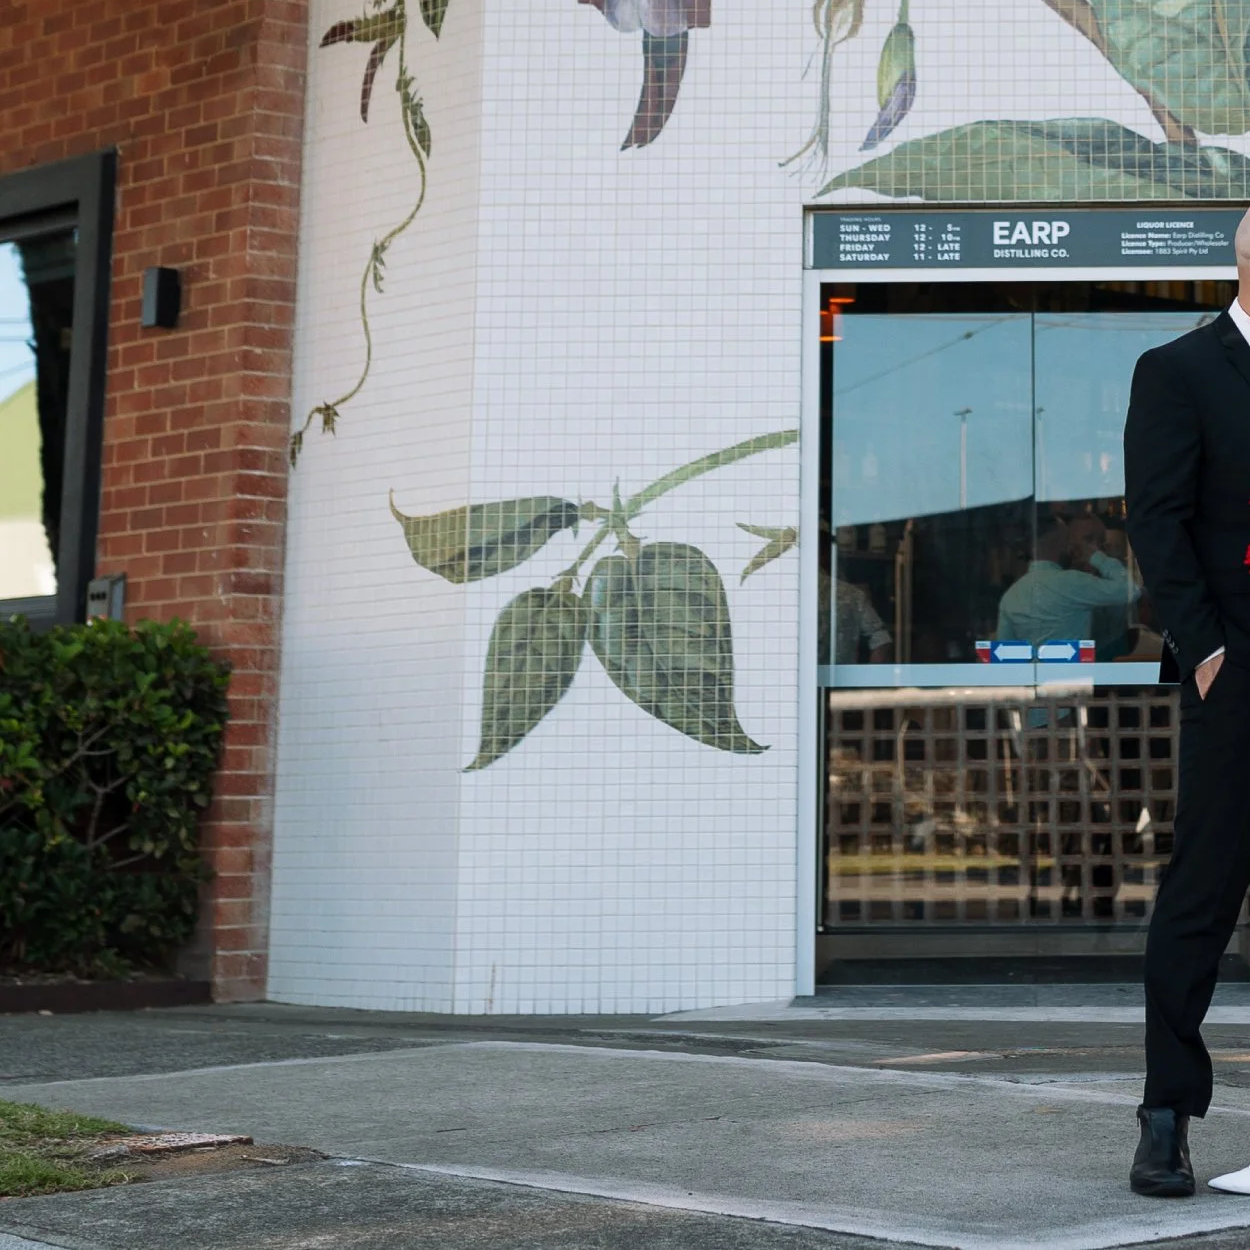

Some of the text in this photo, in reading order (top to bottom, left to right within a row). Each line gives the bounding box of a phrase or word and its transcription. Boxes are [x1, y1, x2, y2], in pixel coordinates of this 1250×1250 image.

[839, 224, 860, 232] SUN
[868, 224, 891, 232] WED
[914, 224, 926, 232] 12
[993, 221, 1070, 245] EARP
[839, 234, 891, 242] THURSDAY
[914, 234, 926, 242] 12
[839, 243, 875, 252] FRIDAY
[913, 243, 926, 251] 12
[937, 243, 961, 251] LATE
[839, 253, 890, 262] SATURDAY
[913, 253, 925, 261] 11
[937, 253, 961, 261] LATE
[993, 249, 1070, 258] DISTILLING CO.
